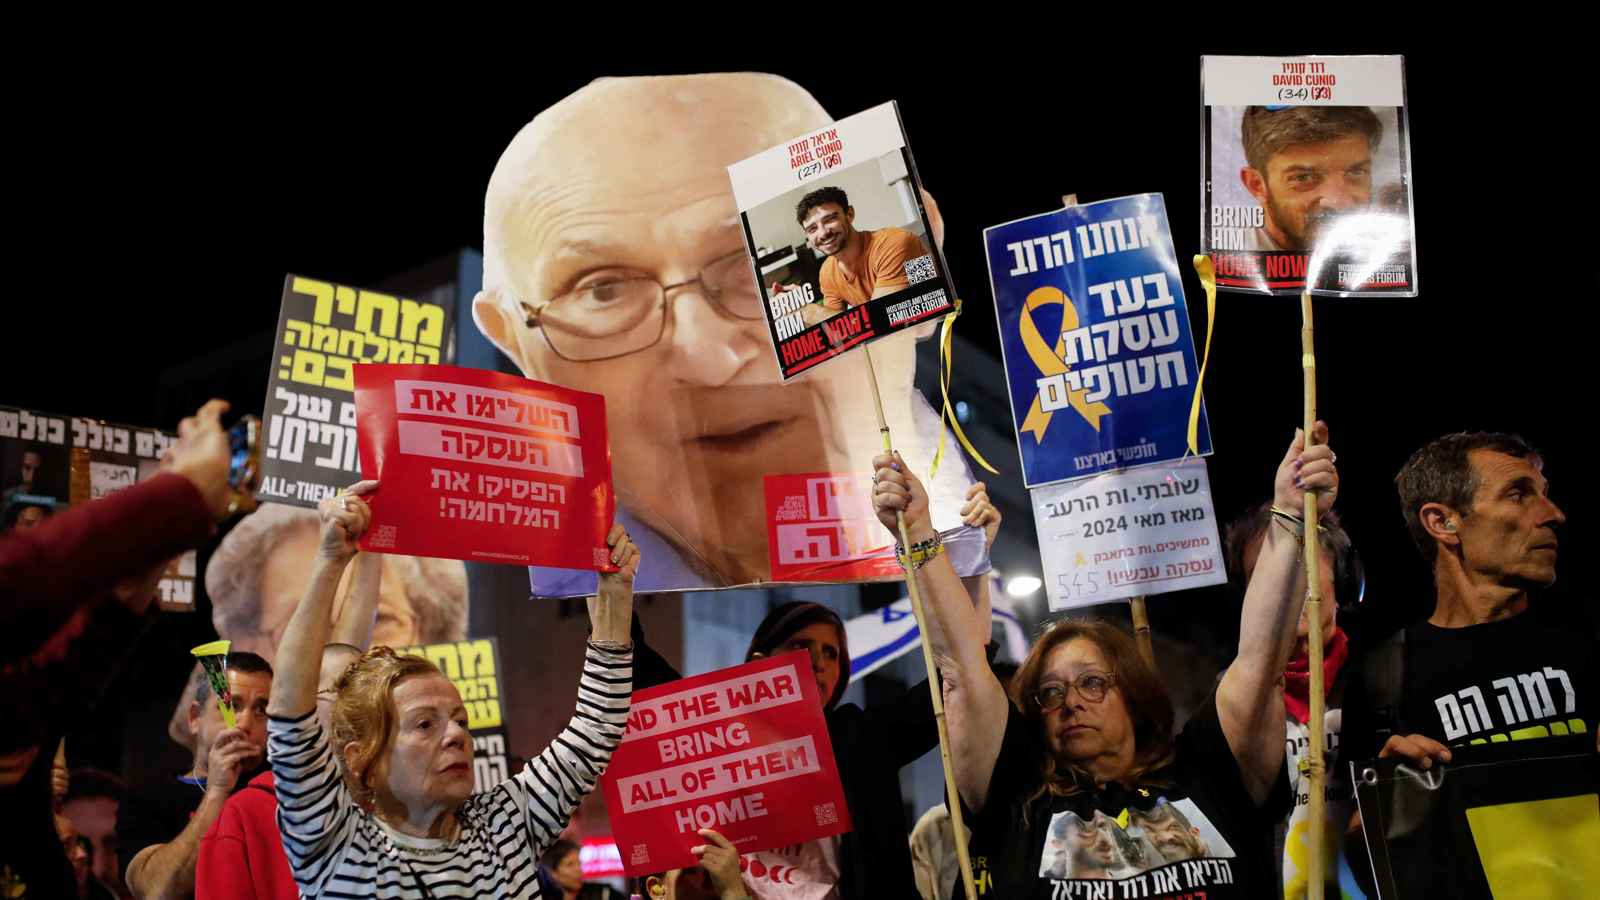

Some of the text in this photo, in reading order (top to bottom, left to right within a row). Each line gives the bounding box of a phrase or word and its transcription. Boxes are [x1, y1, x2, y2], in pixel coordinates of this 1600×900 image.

[1272, 75, 1336, 86] DAVID CUNIO
[1282, 62, 1325, 75] דוד קוניו
[1278, 88, 1308, 100] (34)
[790, 140, 843, 170] ARIEL CUNIO
[810, 129, 838, 149] אריאל
[798, 161, 822, 180] (27)
[1212, 206, 1264, 227] BRING
[1007, 215, 1160, 277] אנחנו הרוב
[1212, 228, 1245, 250] HIM
[1088, 272, 1175, 317] בעד
[1376, 272, 1406, 283] FORUM
[292, 276, 445, 348] מחיר
[769, 281, 815, 320] BRING
[888, 295, 948, 324] FAMILIES FORUM
[284, 319, 441, 365] המלחמה
[774, 312, 806, 342] HIM
[780, 304, 872, 367] HOME NOW!
[1062, 310, 1180, 365] עסקת
[278, 350, 354, 392] כם:
[1037, 350, 1188, 412] חטופים
[275, 386, 332, 421] של
[410, 388, 570, 433] השלימו את
[0, 410, 65, 445] כולם
[72, 417, 130, 454] כולל
[266, 414, 361, 474] ופים!
[441, 429, 549, 467] העסקה
[260, 475, 288, 497] ALL
[297, 480, 335, 502] THEM
[431, 468, 566, 505] הפסיקו את
[440, 497, 560, 530] המלחמה!
[1046, 495, 1100, 519] הרעב
[1083, 507, 1205, 538] מאז מאי 2024
[1057, 571, 1100, 600] 545
[1166, 558, 1214, 579] עסקה
[624, 674, 795, 735] ND THE WAR
[1434, 685, 1494, 741] הם
[1492, 666, 1576, 726] למה
[658, 721, 750, 763] BRING
[630, 744, 809, 806] ALL OF THEM
[674, 792, 768, 834] HOME
[1118, 875, 1147, 899] דוד
[1153, 867, 1185, 895] את
[1182, 859, 1234, 888] הביאו
